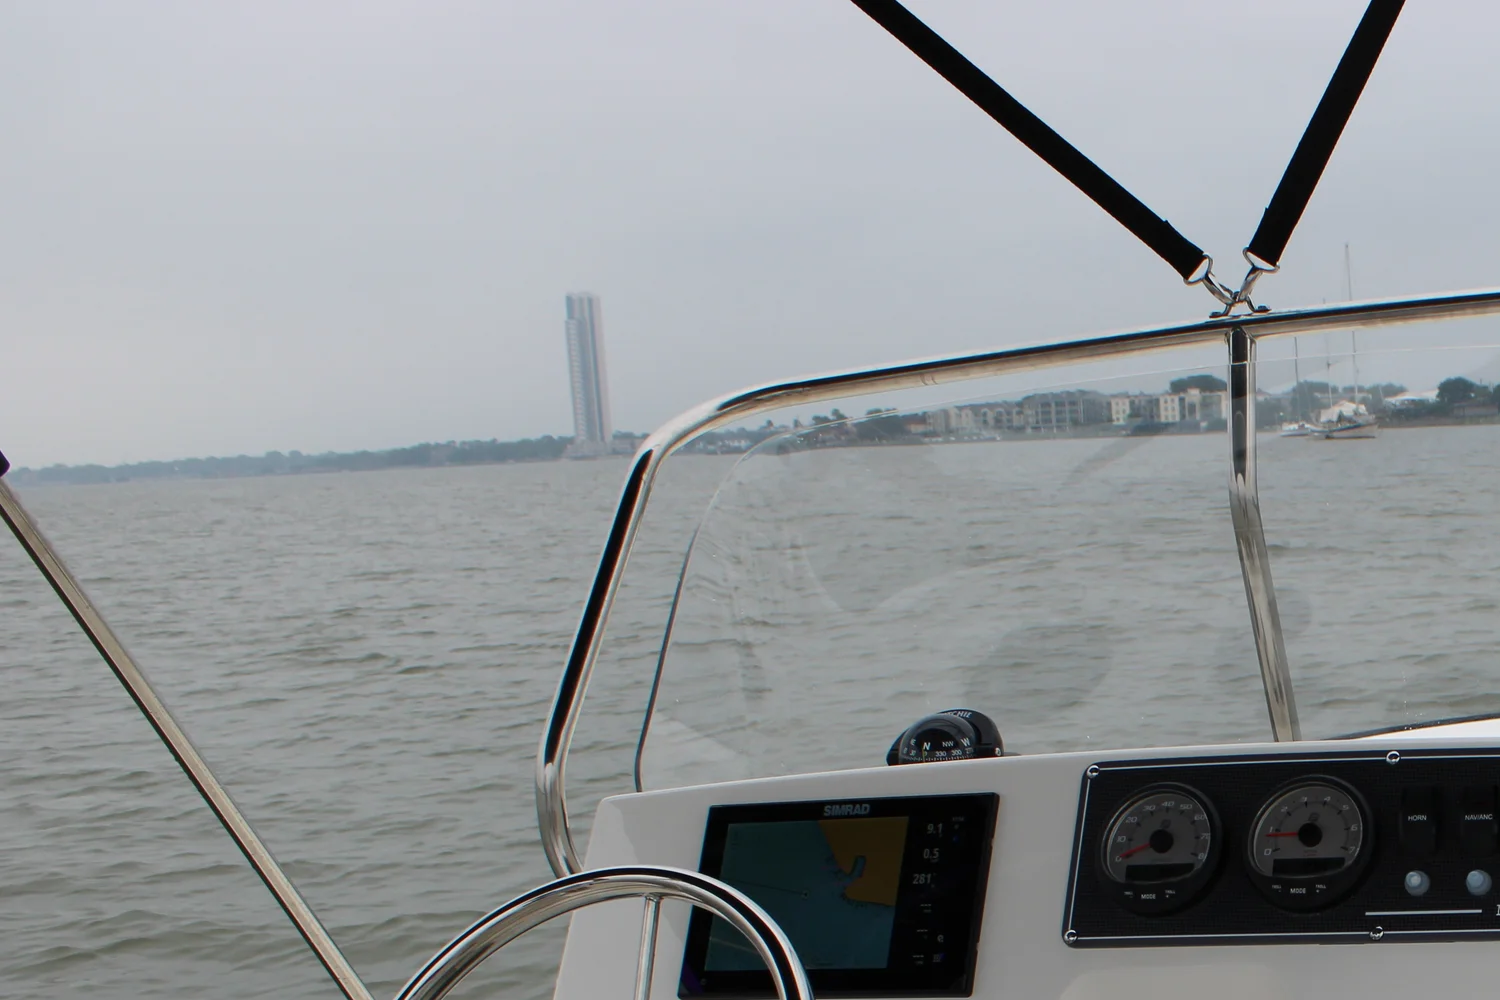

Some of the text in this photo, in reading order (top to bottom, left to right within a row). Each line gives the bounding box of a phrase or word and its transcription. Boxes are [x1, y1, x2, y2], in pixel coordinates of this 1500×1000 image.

[923, 742, 931, 750] N
[961, 737, 971, 747] W
[823, 804, 871, 816] SIMRAD
[1125, 816, 1138, 824] 20
[927, 823, 943, 835] 9.1
[923, 848, 939, 860] 0.5
[1264, 848, 1272, 856] 0
[913, 873, 932, 885] 281
